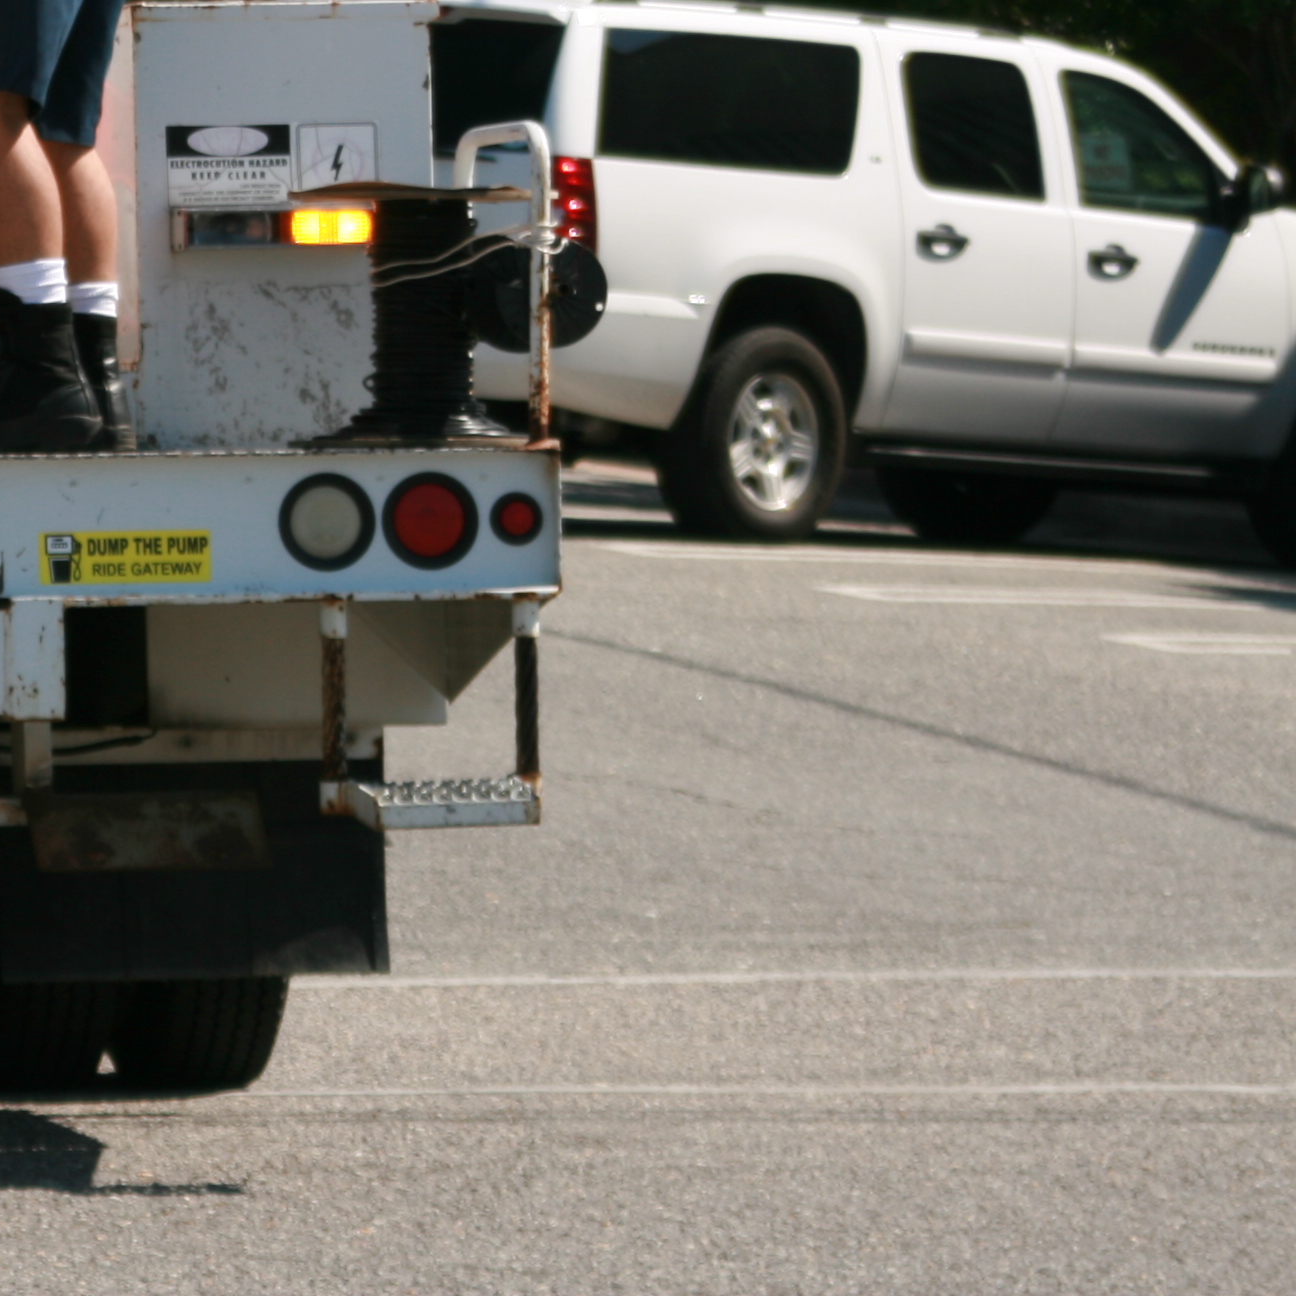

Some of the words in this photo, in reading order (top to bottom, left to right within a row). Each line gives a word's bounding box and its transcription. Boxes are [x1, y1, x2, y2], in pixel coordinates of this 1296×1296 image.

[170, 159, 245, 169] ELECTROCUTION
[248, 158, 288, 168] HAZARD
[191, 172, 221, 180] KEEP
[228, 171, 266, 180] CLEAR
[87, 538, 129, 556] DUMP
[133, 538, 163, 555] THE
[167, 536, 208, 555] PUMP
[92, 562, 127, 577] RIDE
[131, 562, 203, 577] GATEWAY
